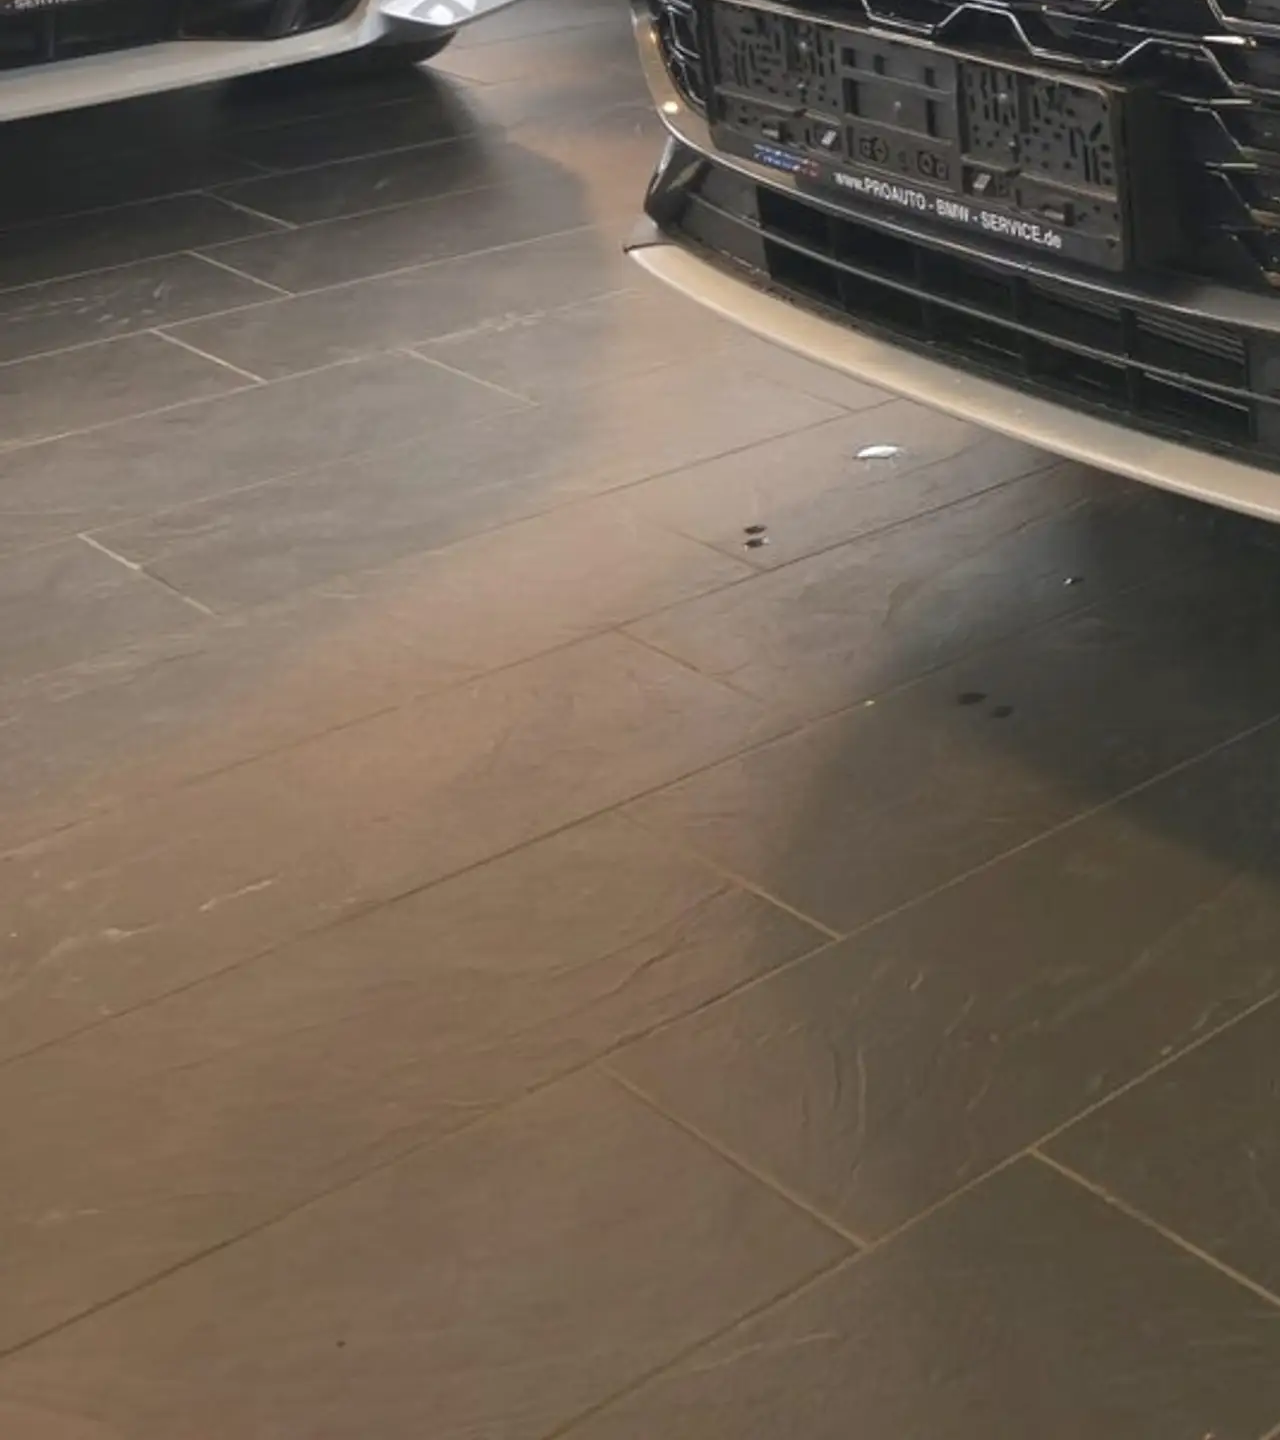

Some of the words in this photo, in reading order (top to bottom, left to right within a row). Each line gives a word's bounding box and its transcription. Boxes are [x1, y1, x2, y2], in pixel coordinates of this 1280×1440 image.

[833, 171, 926, 211] www.PROAUTO
[935, 198, 969, 223] BMW
[980, 211, 1062, 249] SERVICE.de
